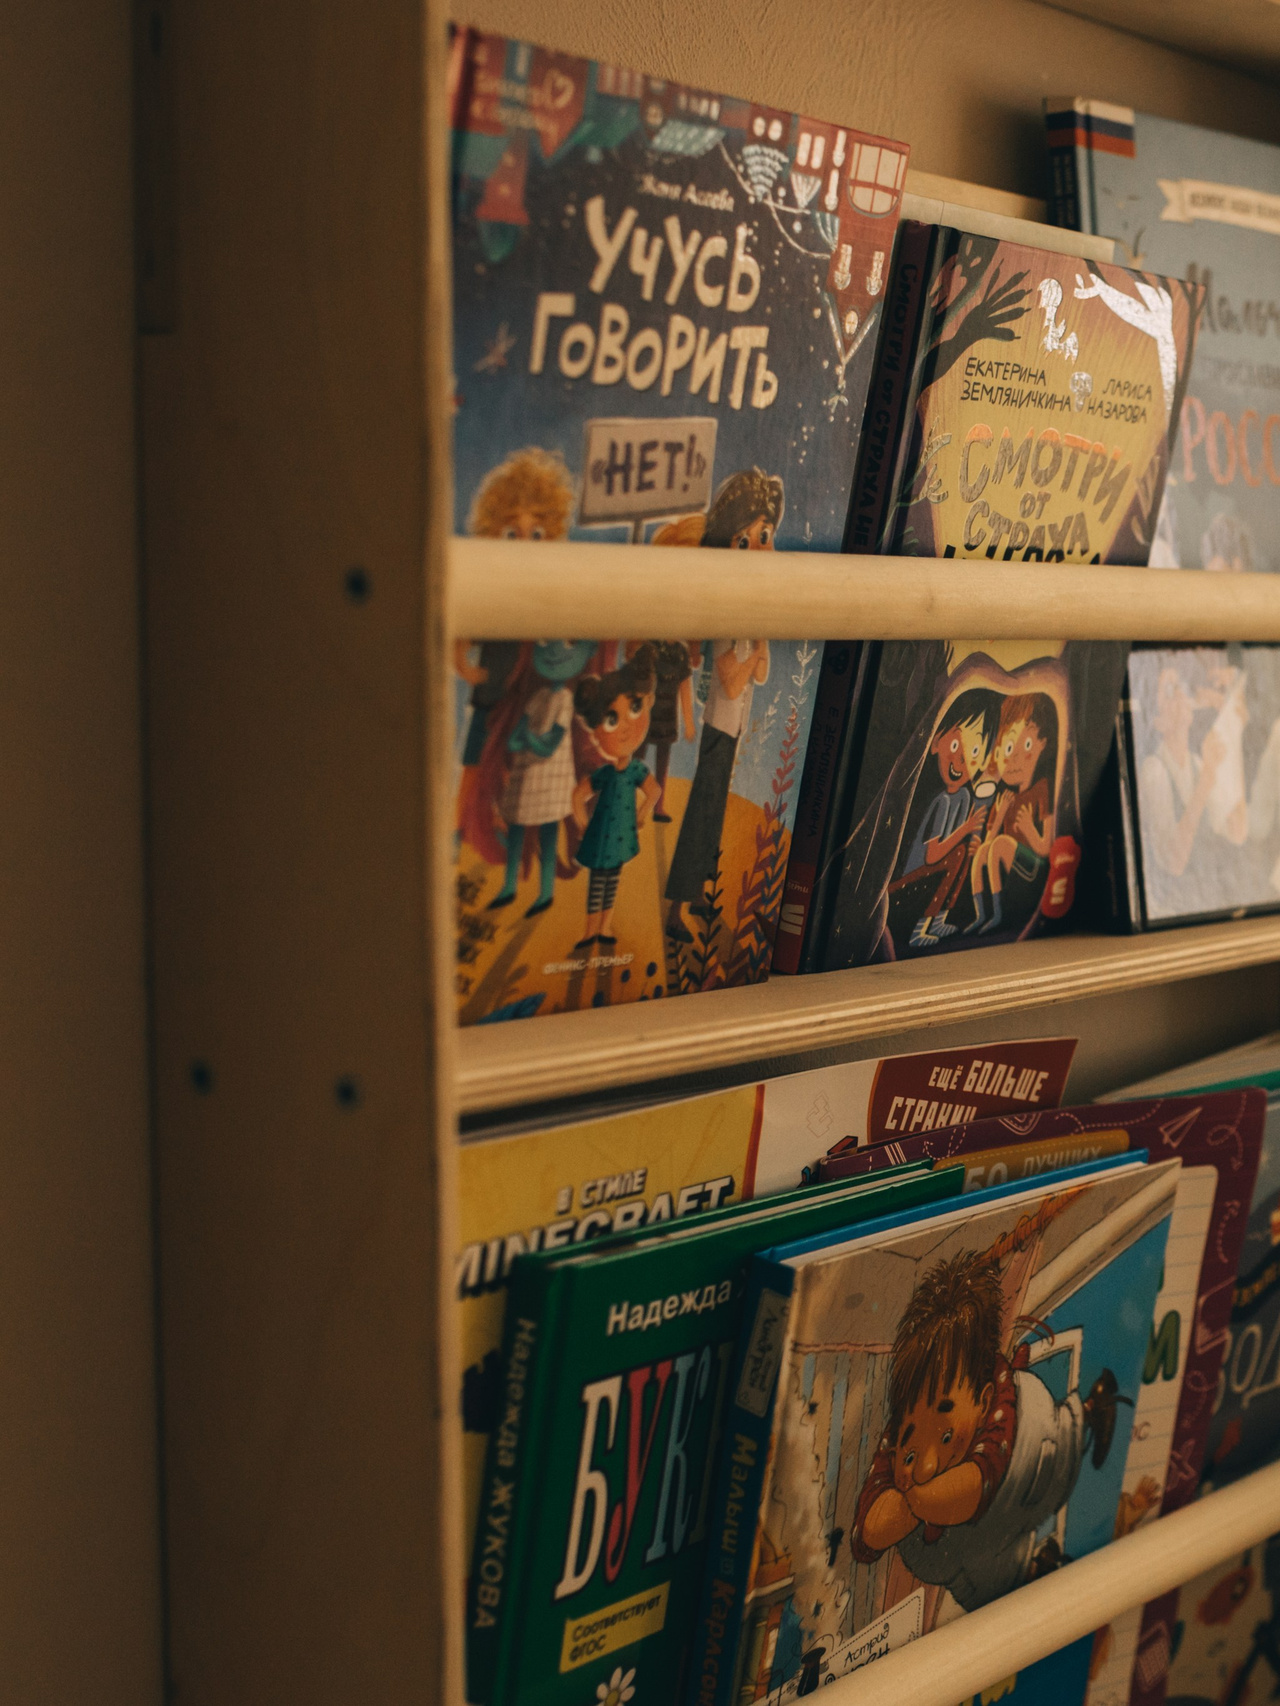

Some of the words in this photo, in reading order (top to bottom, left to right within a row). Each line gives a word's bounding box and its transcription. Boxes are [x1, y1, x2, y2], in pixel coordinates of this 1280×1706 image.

[584, 195, 762, 313] УЧУСЬ
[884, 264, 918, 372] СМОТРИ
[528, 292, 779, 410] ГОВОРИТЬ
[964, 356, 1047, 386] ЕКАТЕРИНА
[960, 379, 1072, 413] ЗЕМЛЯНИЧКИНА
[1087, 395, 1148, 424] НАЗАРОВА
[1102, 378, 1153, 403] ЛАРИСА
[859, 411, 891, 508] СТРАХА
[959, 423, 1132, 526] СМОТРИ
[963, 499, 1091, 564] СТРАХА
[542, 953, 635, 976] ФЕНИКС-ПРЕМЬЕР
[928, 1064, 964, 1092] ЕЩЁ
[963, 1059, 1050, 1104] БОЛЬШЕ
[581, 1167, 649, 1208] СТИЛЕ
[962, 1161, 1009, 1195] 50
[605, 1279, 733, 1338] Надежда
[495, 1317, 539, 1469] Надежда
[720, 1433, 760, 1554] Малыш
[472, 1477, 517, 1630] ЖУКОВА
[572, 1595, 662, 1642] Соответствует
[569, 1634, 607, 1663] ФГОС
[843, 1622, 891, 1668] Астрид
